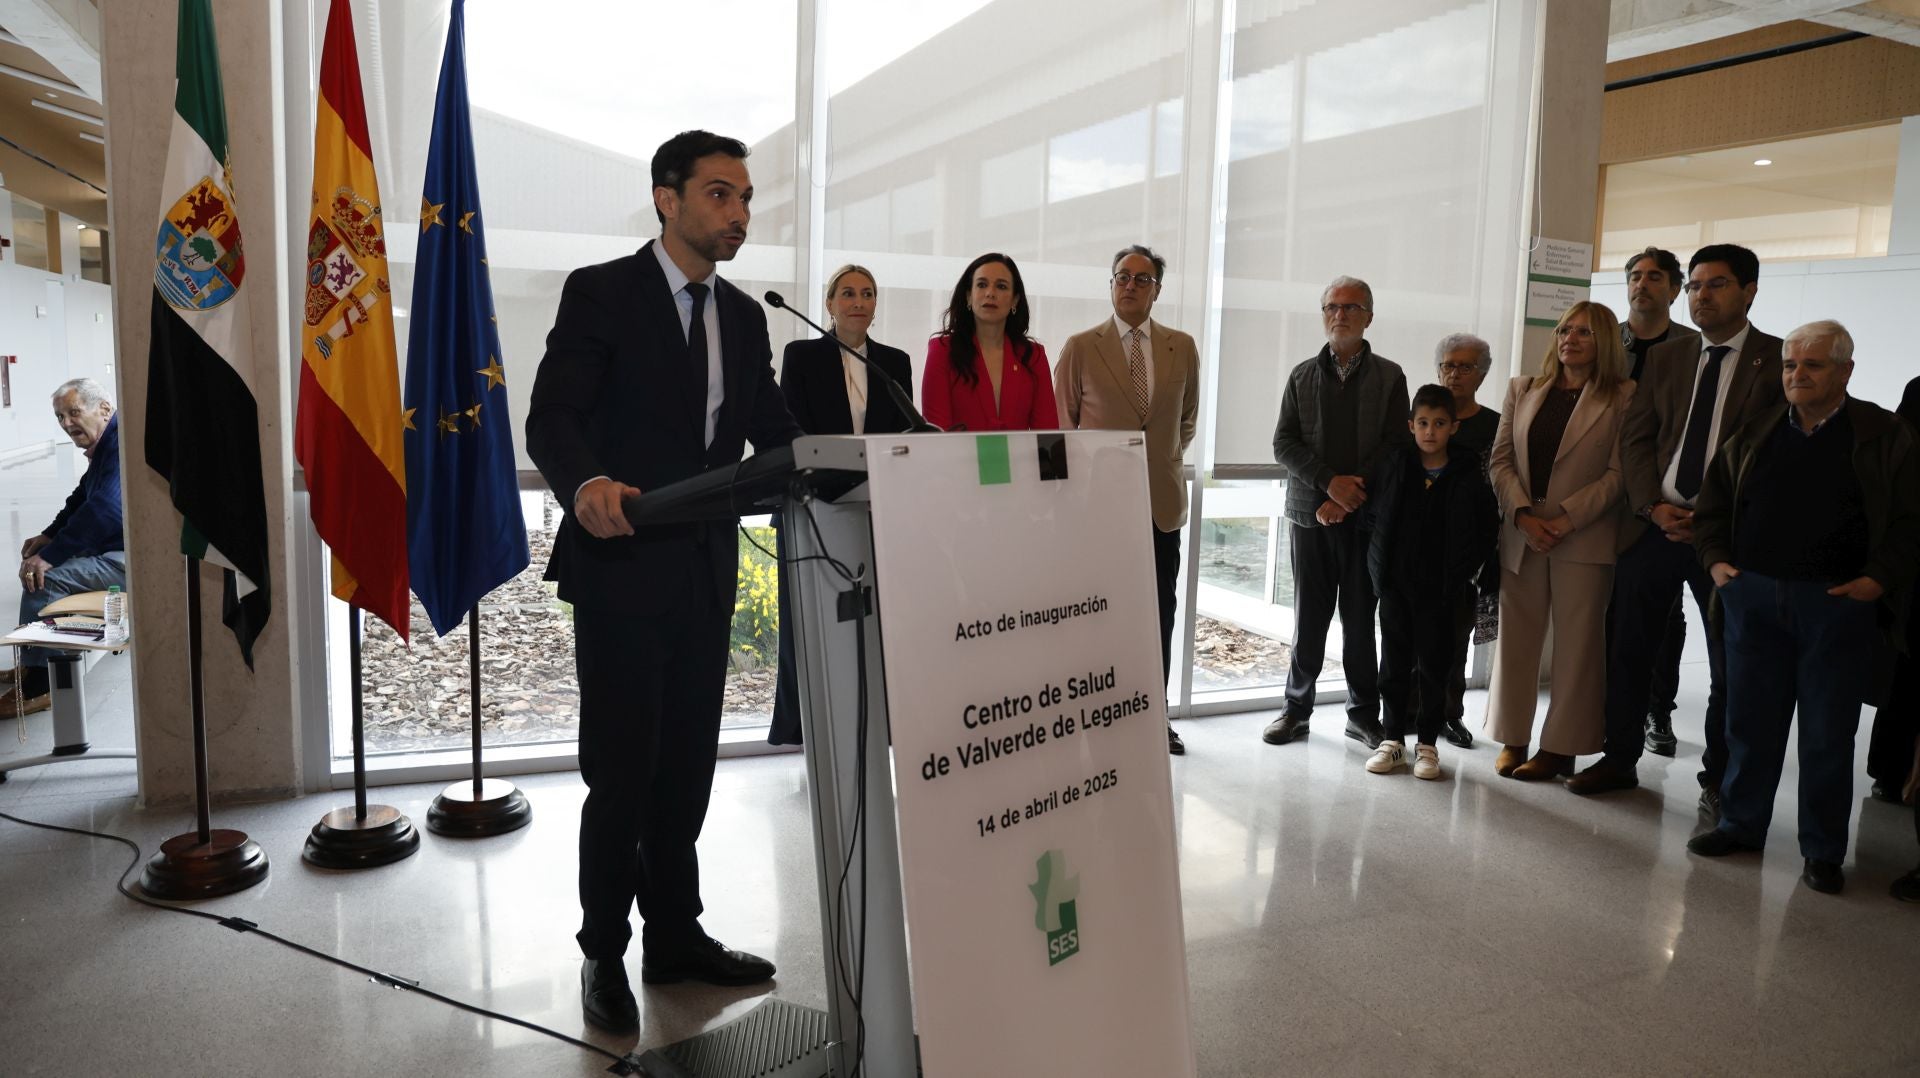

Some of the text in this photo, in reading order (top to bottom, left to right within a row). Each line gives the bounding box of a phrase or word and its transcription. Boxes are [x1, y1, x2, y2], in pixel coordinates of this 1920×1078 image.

[184, 275, 200, 296] VLTRA
[956, 596, 1108, 641] Acto de inauguración
[963, 666, 1115, 729] Centro de Salud
[922, 691, 1149, 781] de Valverde de Leganés
[977, 769, 1117, 837] 14 de abril de 2025
[1050, 929, 1077, 959] SES
